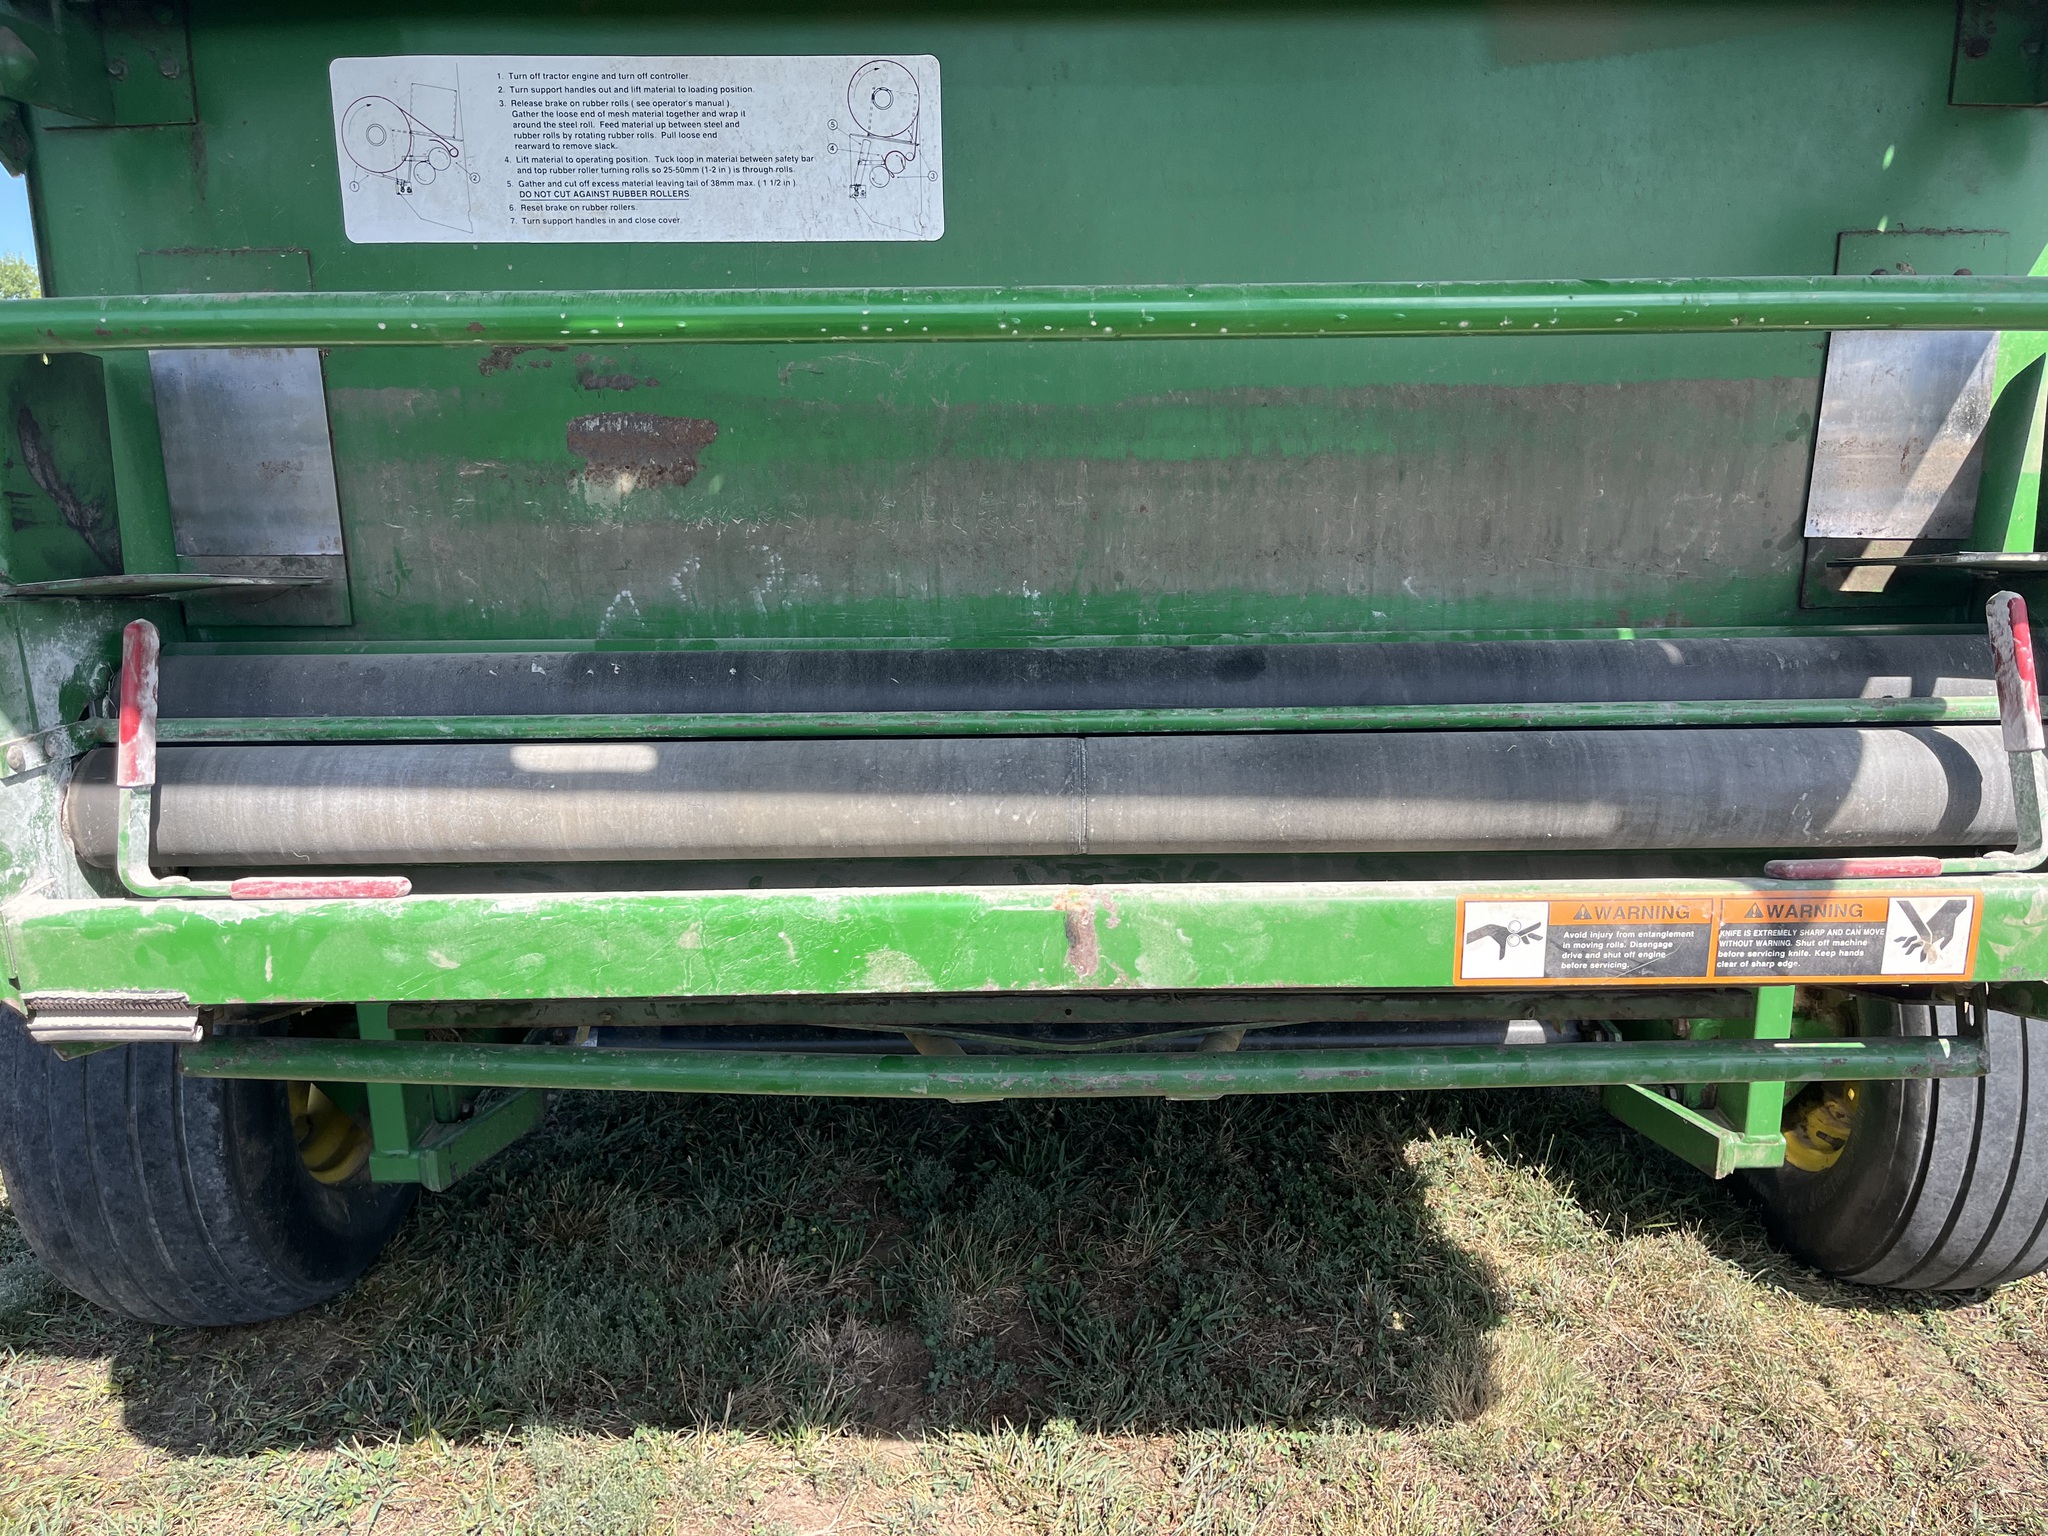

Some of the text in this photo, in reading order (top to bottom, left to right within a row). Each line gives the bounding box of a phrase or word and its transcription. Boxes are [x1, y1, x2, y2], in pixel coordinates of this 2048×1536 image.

[508, 72, 527, 80] Turn
[529, 72, 540, 80] off
[542, 72, 569, 80] tractor
[572, 72, 599, 81] engine
[601, 72, 616, 80] and
[618, 72, 635, 80] turn
[637, 72, 648, 80] off
[509, 86, 529, 94] Turn
[531, 86, 563, 95] support
[564, 86, 596, 94] handles
[598, 86, 612, 94] out
[613, 86, 629, 94] and
[688, 86, 718, 94] loading
[512, 110, 539, 118] Gather
[541, 110, 554, 118] the
[556, 110, 578, 118] loose
[580, 110, 595, 118] end
[597, 110, 605, 118] of
[608, 110, 630, 118] mesh
[666, 111, 699, 119] together
[718, 111, 739, 119] wrap
[512, 121, 541, 129] around
[656, 122, 666, 130] up
[562, 132, 572, 141] by
[575, 132, 606, 141] rotating
[702, 131, 718, 139] end
[515, 142, 550, 150] rearward
[516, 156, 529, 164] Lift
[531, 156, 564, 164] material
[565, 156, 574, 164] to
[576, 156, 614, 165] operating
[676, 156, 694, 164] loop
[775, 156, 799, 164] safety
[534, 167, 548, 175] top
[600, 167, 630, 175] turning
[663, 166, 699, 174] 25-50mm
[742, 166, 774, 174] through
[518, 180, 545, 188] Gather
[656, 180, 684, 188] leaving
[519, 190, 532, 198] DO
[534, 190, 551, 198] NOT
[553, 190, 571, 198] CUT
[573, 190, 610, 198] AGAINST
[612, 190, 648, 198] RUBBER
[522, 217, 540, 225] Turn
[542, 217, 573, 226] support
[1595, 905, 1690, 920] WARNING
[1766, 903, 1863, 919] WARNING
[1590, 931, 1613, 940] injury
[1638, 930, 1695, 940] entanglement
[1753, 929, 1797, 937] EXTREMELY
[1845, 928, 1861, 936] CAN
[1863, 928, 1885, 936] MOVE
[1573, 942, 1603, 950] moving
[1630, 941, 1673, 949] Disengage
[1795, 939, 1815, 947] Shut
[1603, 951, 1621, 959] shut
[1638, 951, 1666, 960] engine
[1717, 950, 1745, 958] before
[1747, 950, 1785, 959] servicing
[1814, 950, 1836, 958] Keep
[1717, 960, 1737, 968] clear
[1751, 960, 1775, 969] sharp
